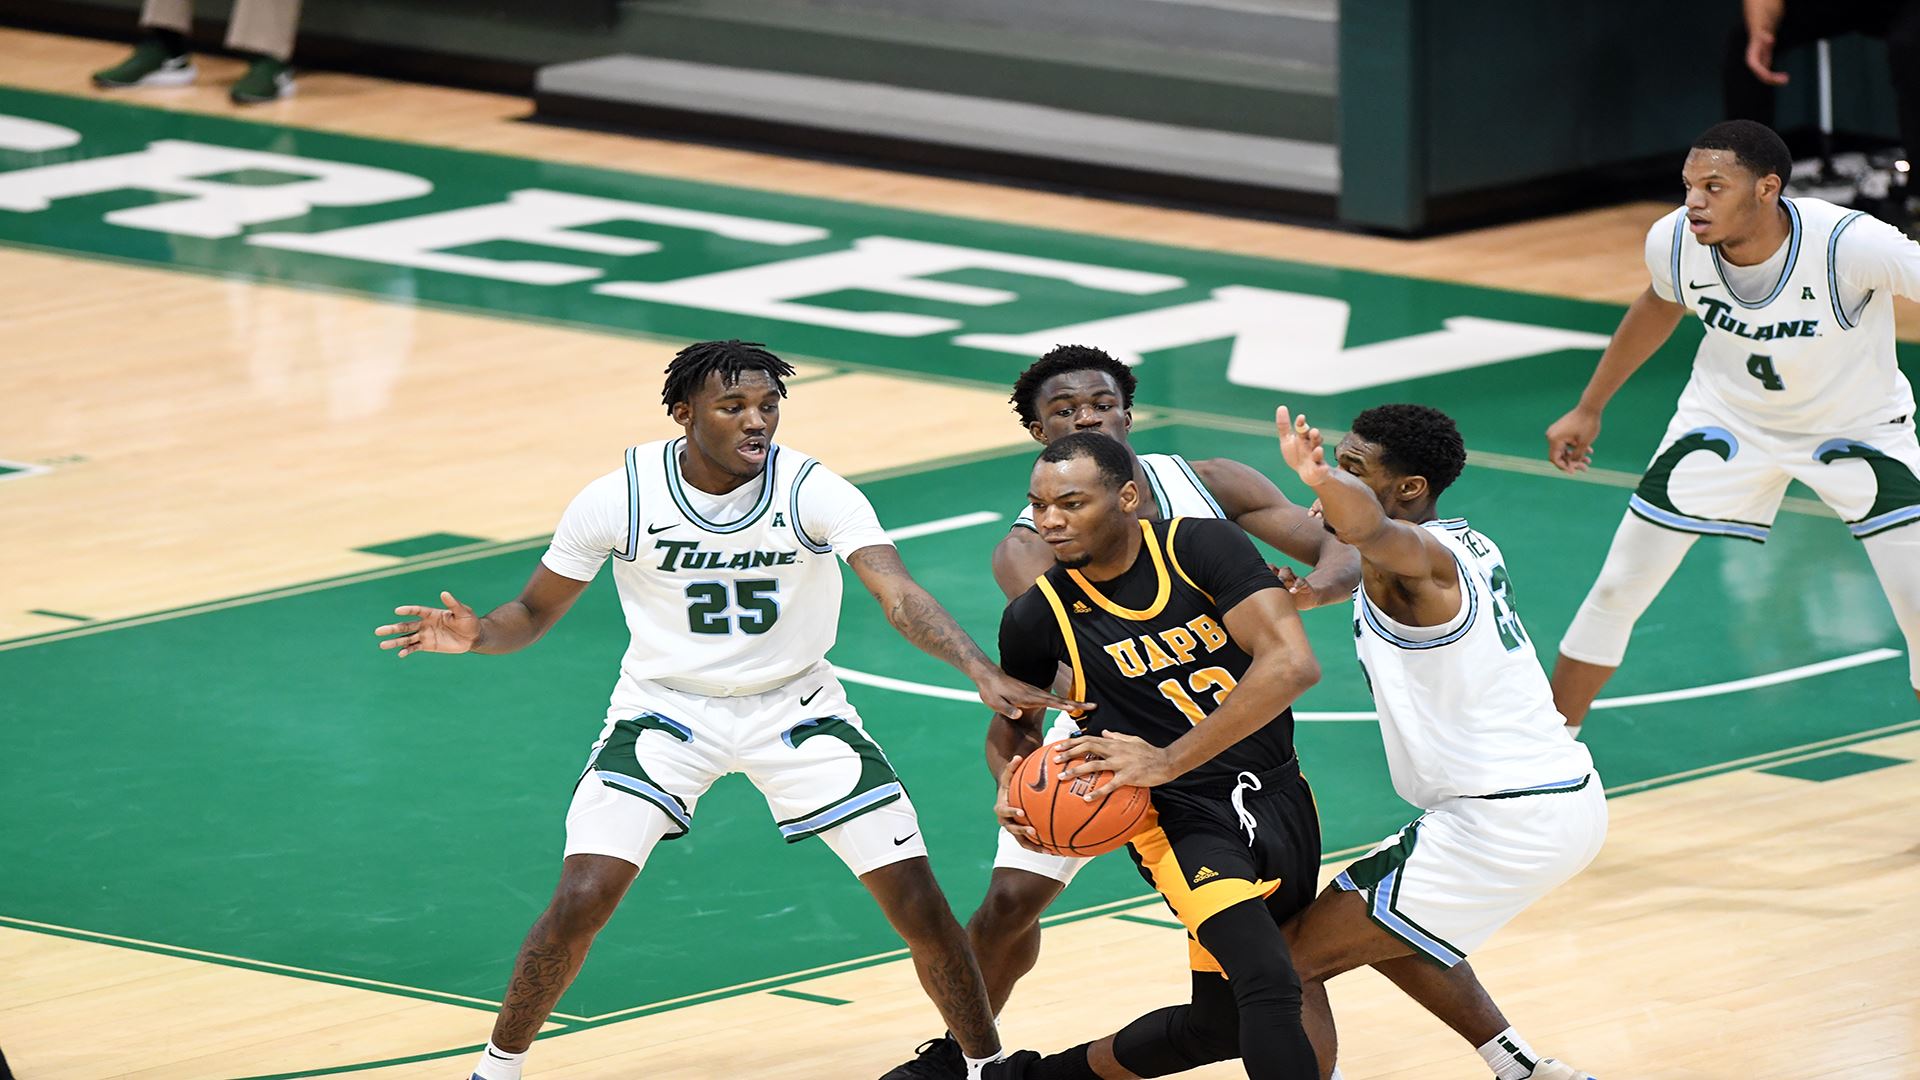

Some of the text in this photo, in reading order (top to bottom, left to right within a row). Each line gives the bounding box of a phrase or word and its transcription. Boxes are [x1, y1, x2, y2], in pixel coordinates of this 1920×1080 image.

[0, 113, 1611, 396] REEN
[1698, 296, 1819, 341] TULANE
[1747, 353, 1785, 391] 4
[655, 540, 798, 572] TULANE
[683, 578, 781, 636] 25
[1103, 613, 1228, 678] UAPB
